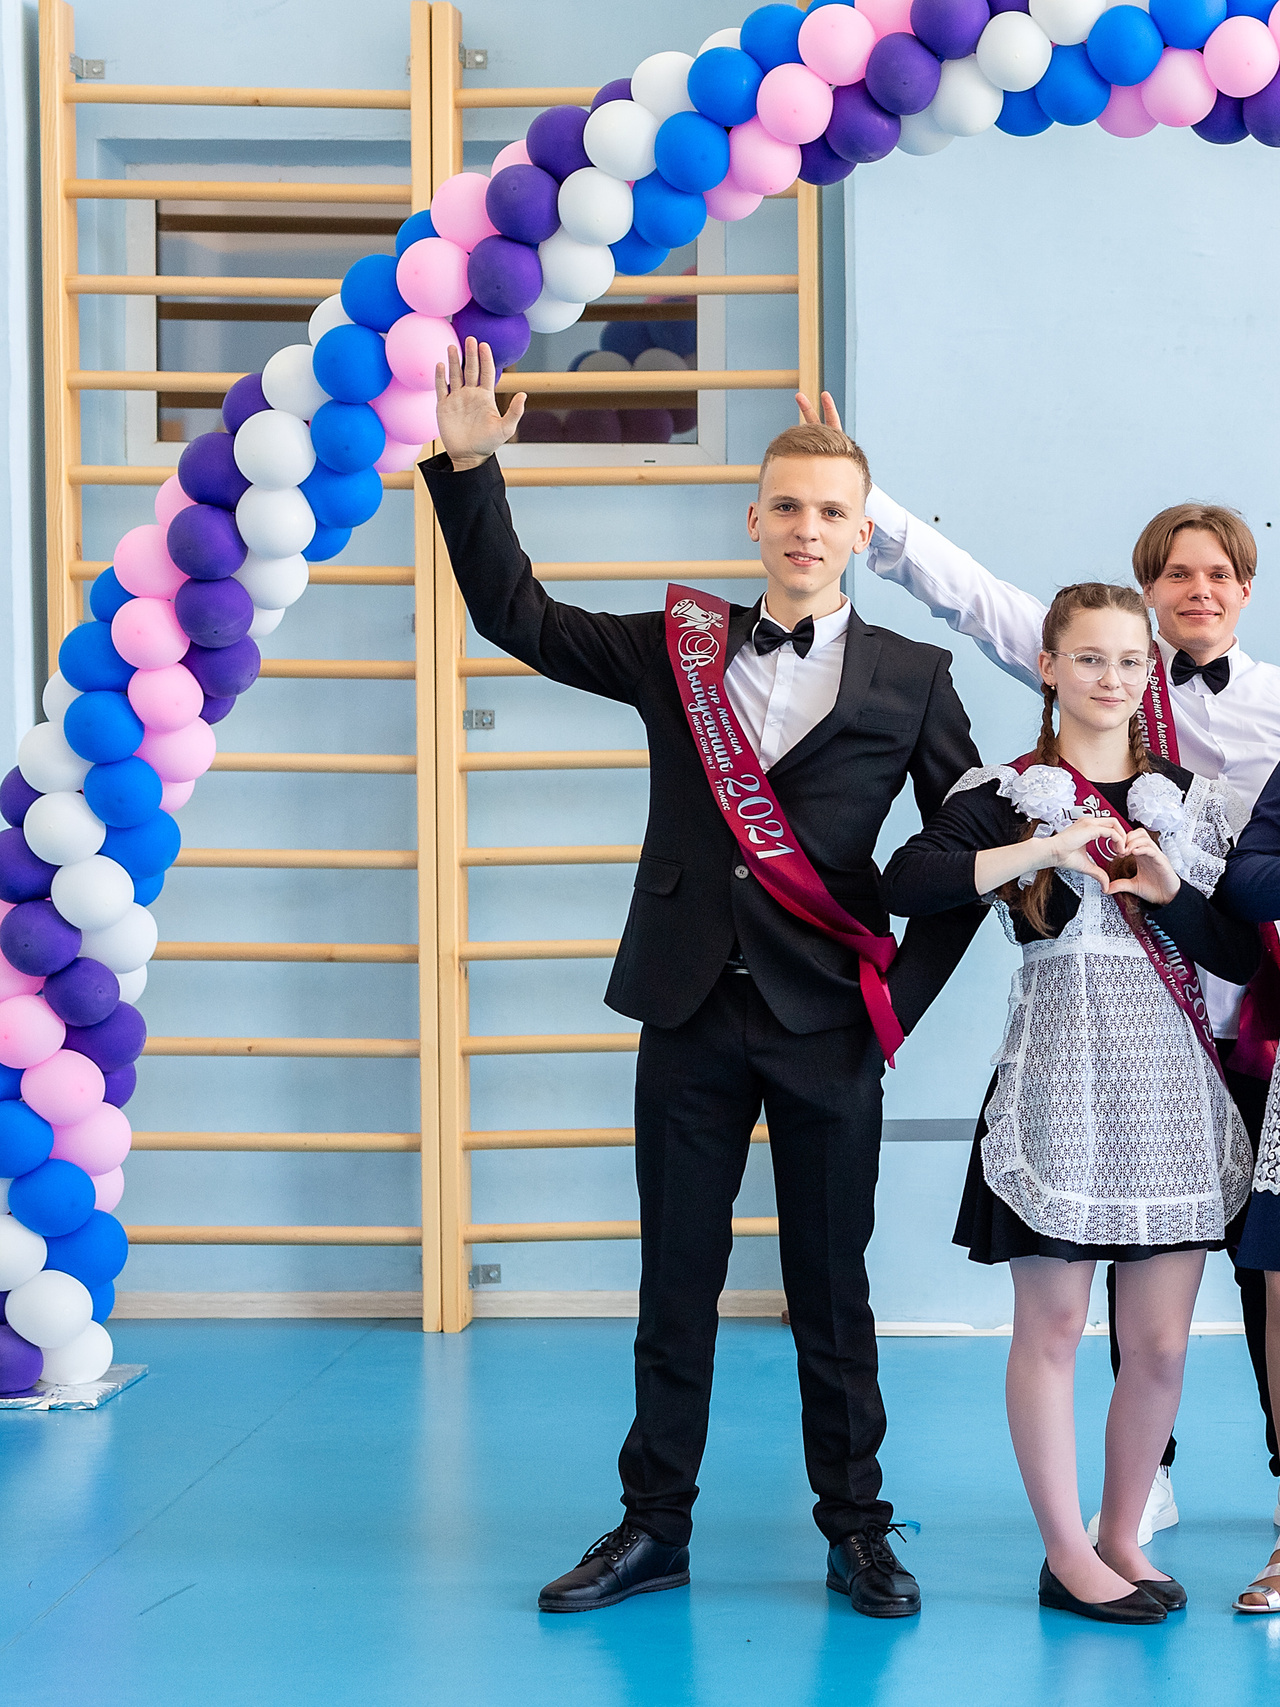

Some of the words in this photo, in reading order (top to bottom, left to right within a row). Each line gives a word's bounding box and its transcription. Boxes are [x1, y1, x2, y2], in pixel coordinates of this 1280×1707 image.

[678, 629, 734, 772] Выпускник
[723, 774, 795, 859] 2021
[692, 714, 705, 736] МБОУ
[699, 736, 711, 754] СОШ
[707, 684, 720, 704] Тур
[716, 707, 743, 755] Максим
[1142, 936, 1157, 954] СОШ
